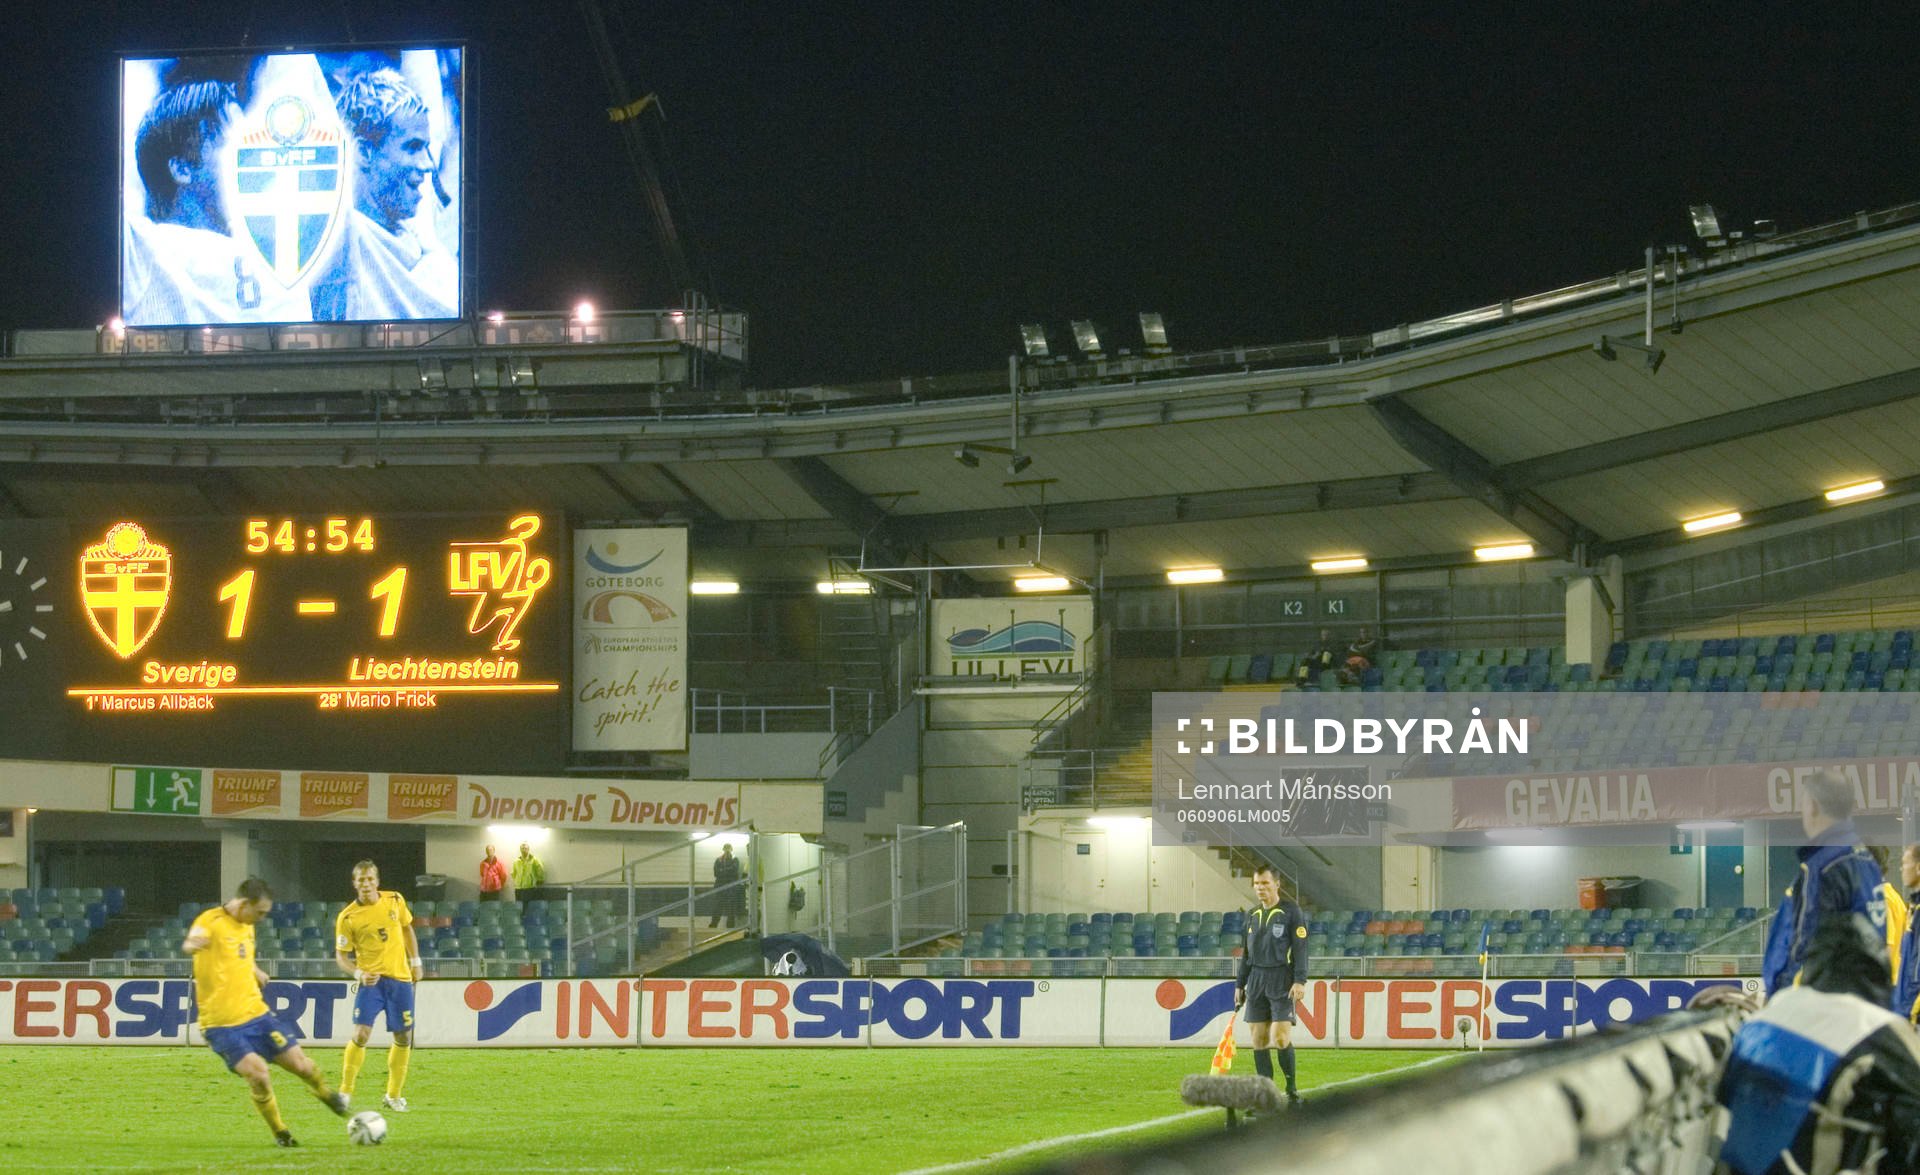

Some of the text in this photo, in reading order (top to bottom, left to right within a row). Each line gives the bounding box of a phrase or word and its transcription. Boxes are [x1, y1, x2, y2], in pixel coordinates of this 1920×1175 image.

[247, 519, 375, 553] 54:54
[449, 551, 521, 590] LFV
[585, 575, 664, 588] GÖTEBORG
[219, 568, 256, 639] 1
[371, 567, 408, 637] 1
[1284, 600, 1303, 615] K2
[1328, 599, 1344, 614] K1
[143, 660, 238, 688] Sverige
[350, 656, 519, 681] Liechtenstein
[579, 666, 680, 703] Catch the
[102, 695, 156, 710] Marcus
[159, 694, 215, 710] Allbäck
[346, 691, 391, 708] Mario
[395, 690, 436, 707] Frick
[593, 694, 662, 738] spirit!
[216, 777, 277, 792] TRIUMF
[304, 779, 365, 794] TRIUMF
[393, 782, 453, 796] TRIUMF
[226, 793, 265, 803] GLASS
[313, 795, 353, 806] GLASS
[401, 798, 441, 809] GLASS
[1504, 773, 1658, 825] GEVALIA
[377, 927, 389, 943] 5
[402, 1009, 413, 1027] 5
[555, 979, 1034, 1040] INTERSPORT
